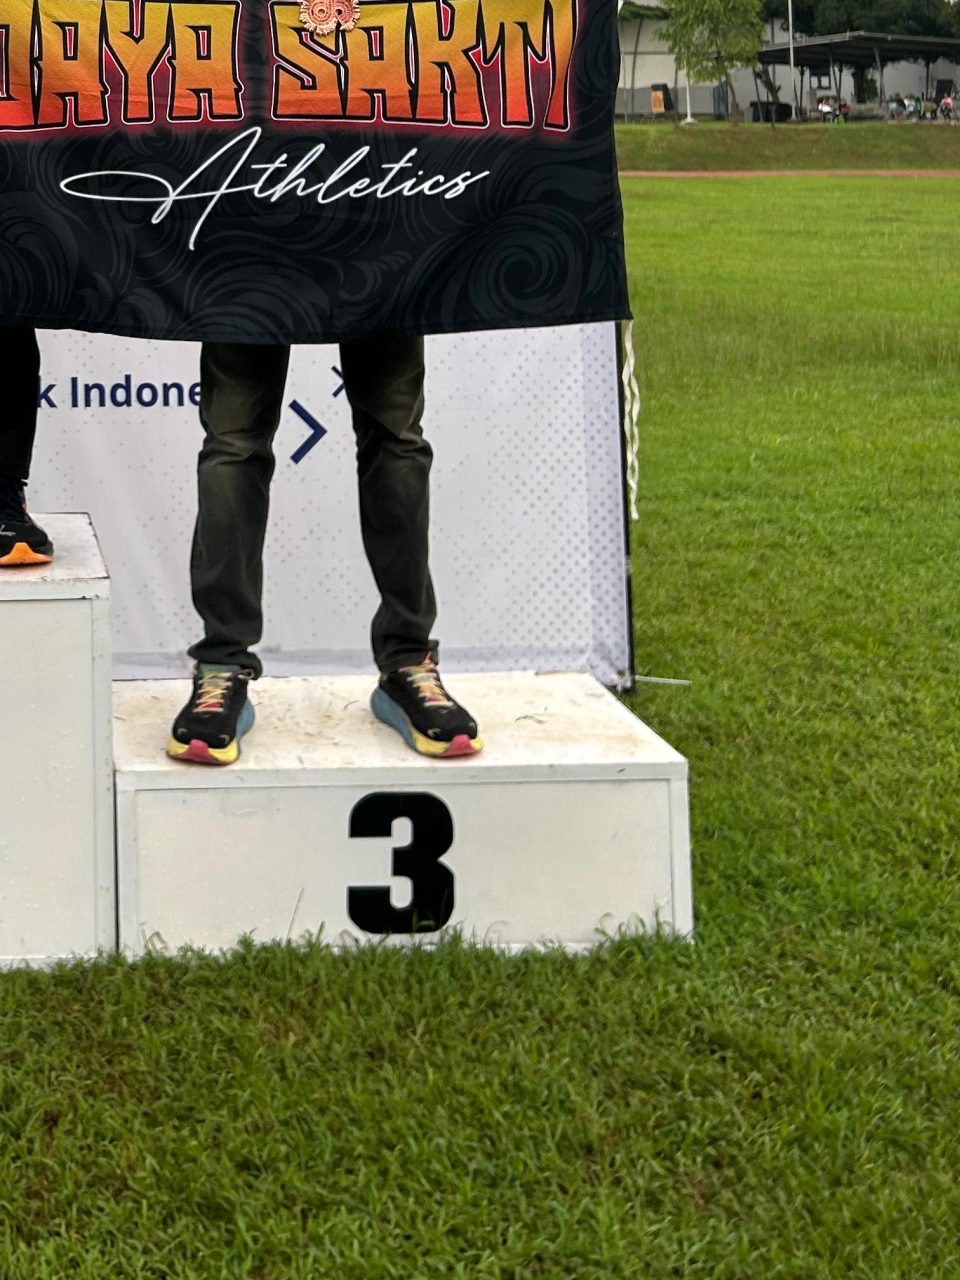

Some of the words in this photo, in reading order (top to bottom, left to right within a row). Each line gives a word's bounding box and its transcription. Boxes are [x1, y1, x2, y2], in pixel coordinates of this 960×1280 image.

[60, 126, 490, 251] Athletics
[70, 374, 201, 408] Indone
[349, 793, 454, 935] 3
